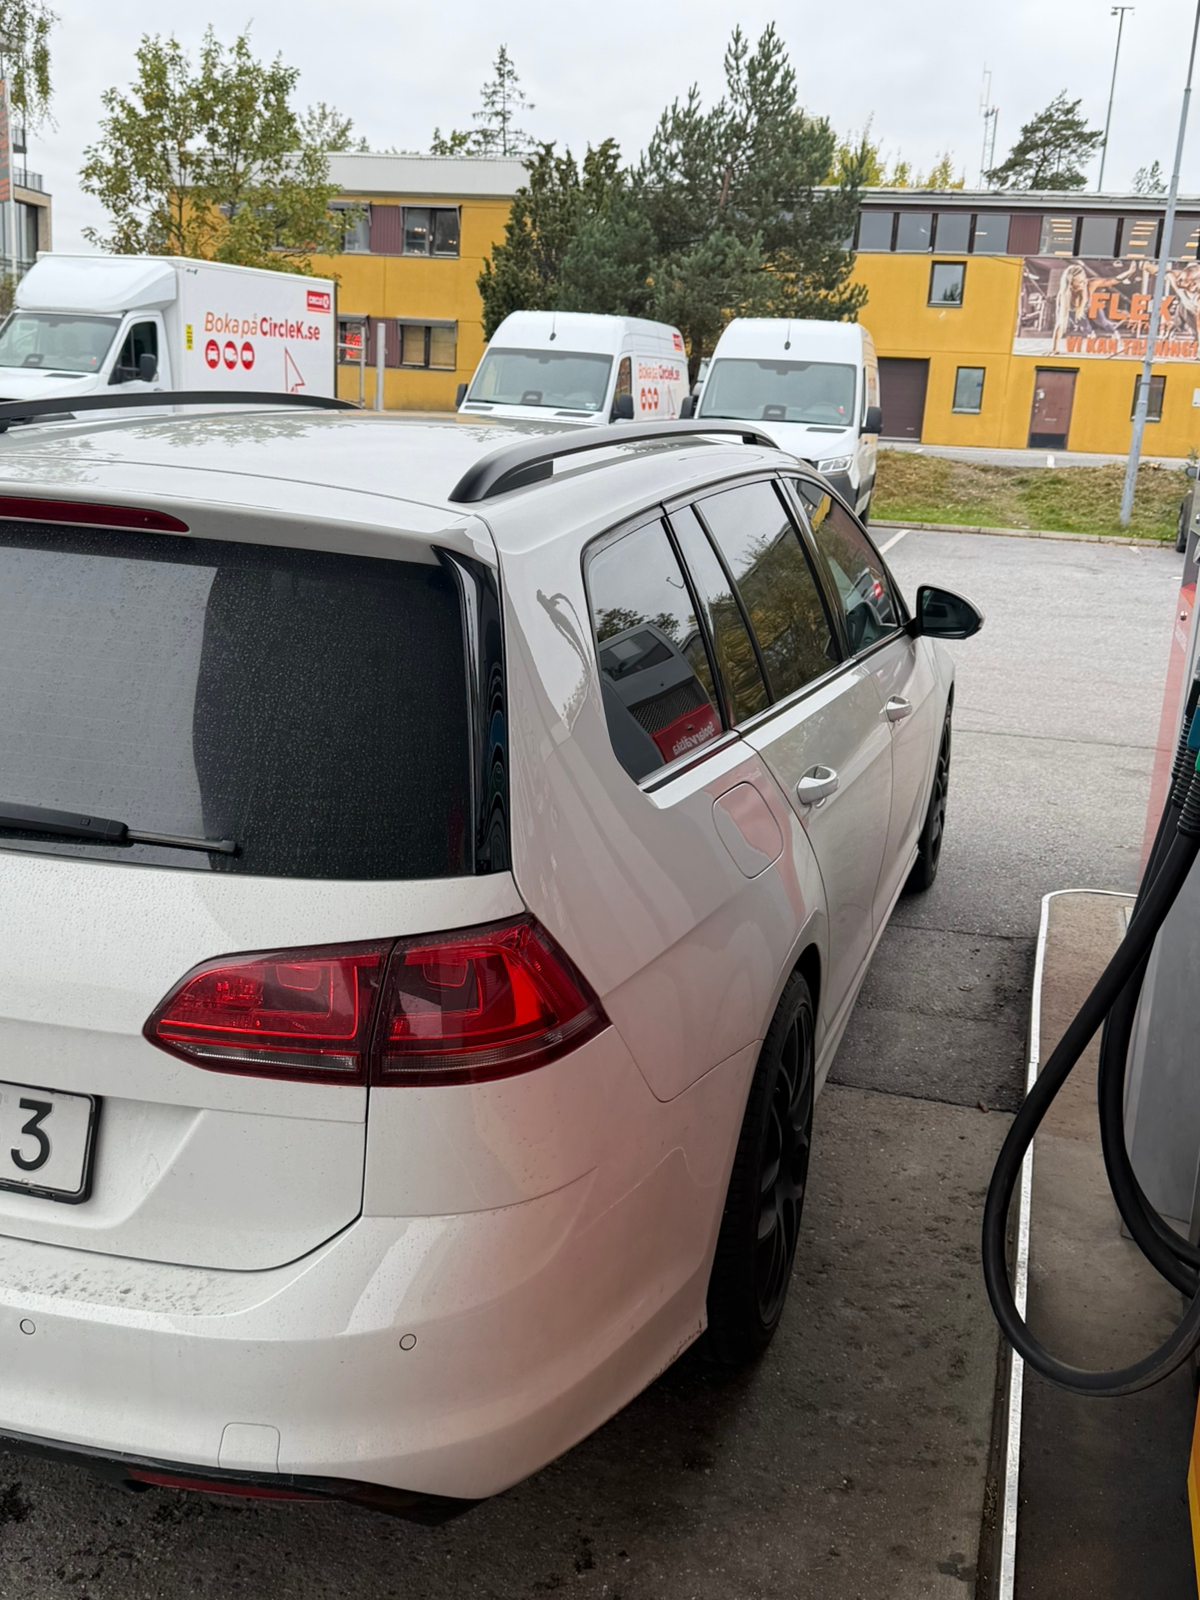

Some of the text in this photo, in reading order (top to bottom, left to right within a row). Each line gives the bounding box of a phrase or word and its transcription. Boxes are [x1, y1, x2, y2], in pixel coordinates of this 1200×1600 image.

[204, 311, 239, 334] Boka
[241, 313, 258, 338] på
[260, 317, 320, 341] CircleK.se
[1065, 336, 1082, 352] VI
[1085, 337, 1117, 355] KAN
[11, 1097, 52, 1171] 3
